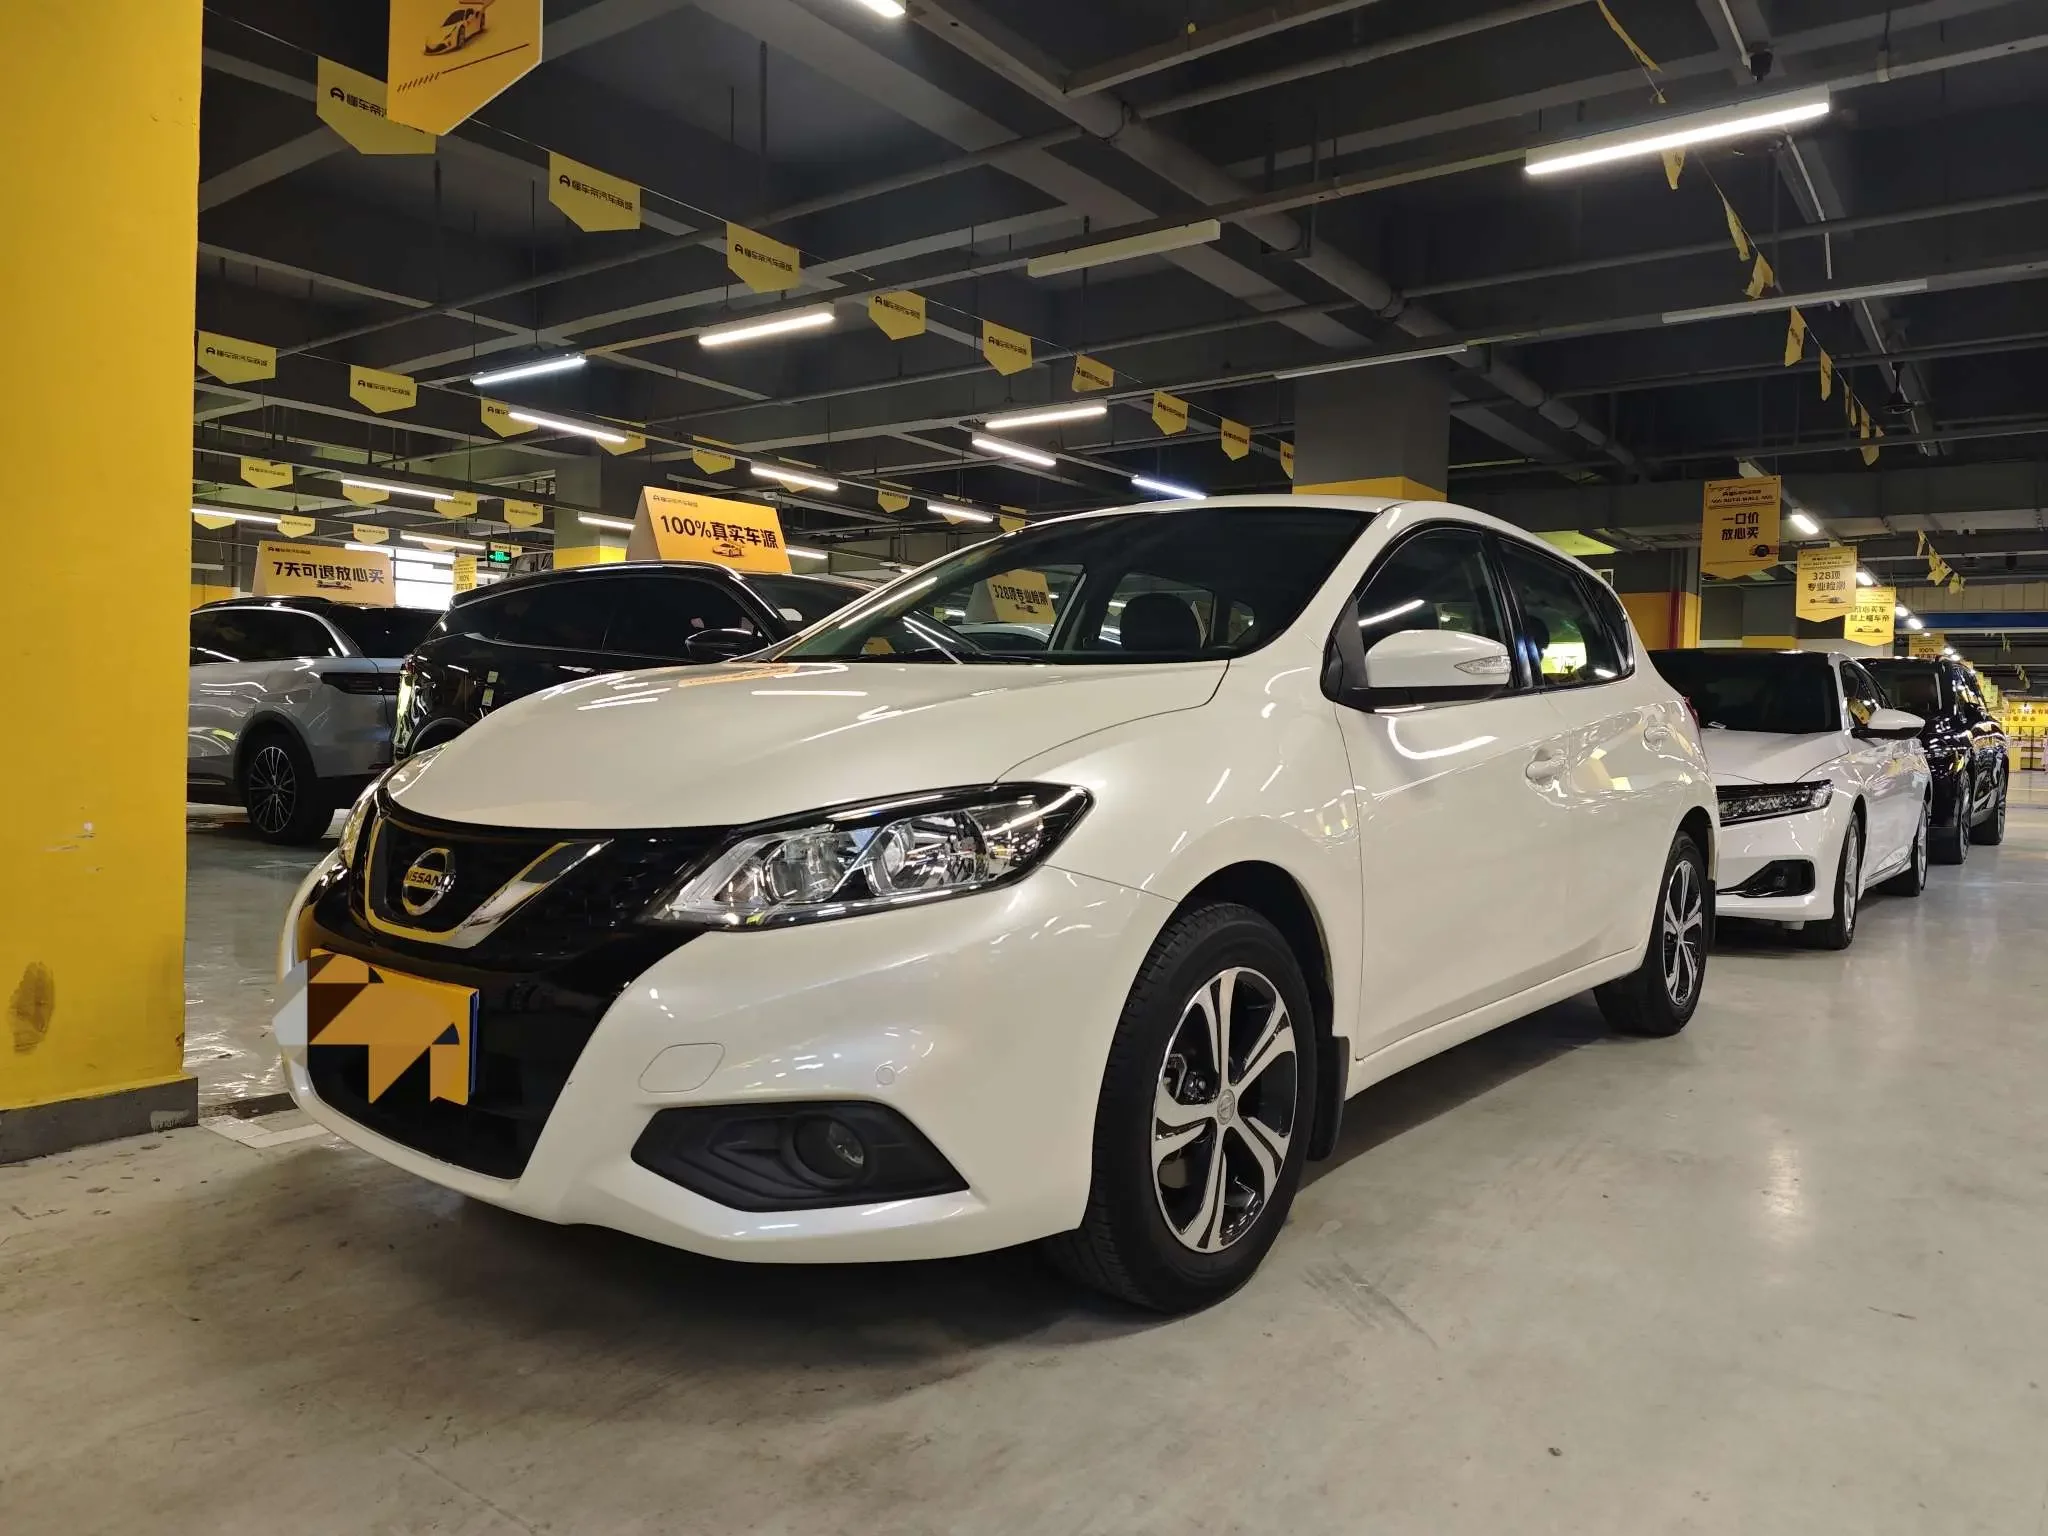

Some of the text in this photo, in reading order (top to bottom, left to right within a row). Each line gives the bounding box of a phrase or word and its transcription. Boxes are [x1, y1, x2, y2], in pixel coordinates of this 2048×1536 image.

[1722, 512, 1759, 525] 一口价
[660, 515, 779, 549] 100%真实车源
[1721, 527, 1759, 541] 放心买
[273, 561, 385, 584] 7天可退放心买
[1813, 570, 1841, 580] 328项
[1808, 581, 1846, 592] 专业检测
[993, 584, 1049, 606] 328项专业检测
